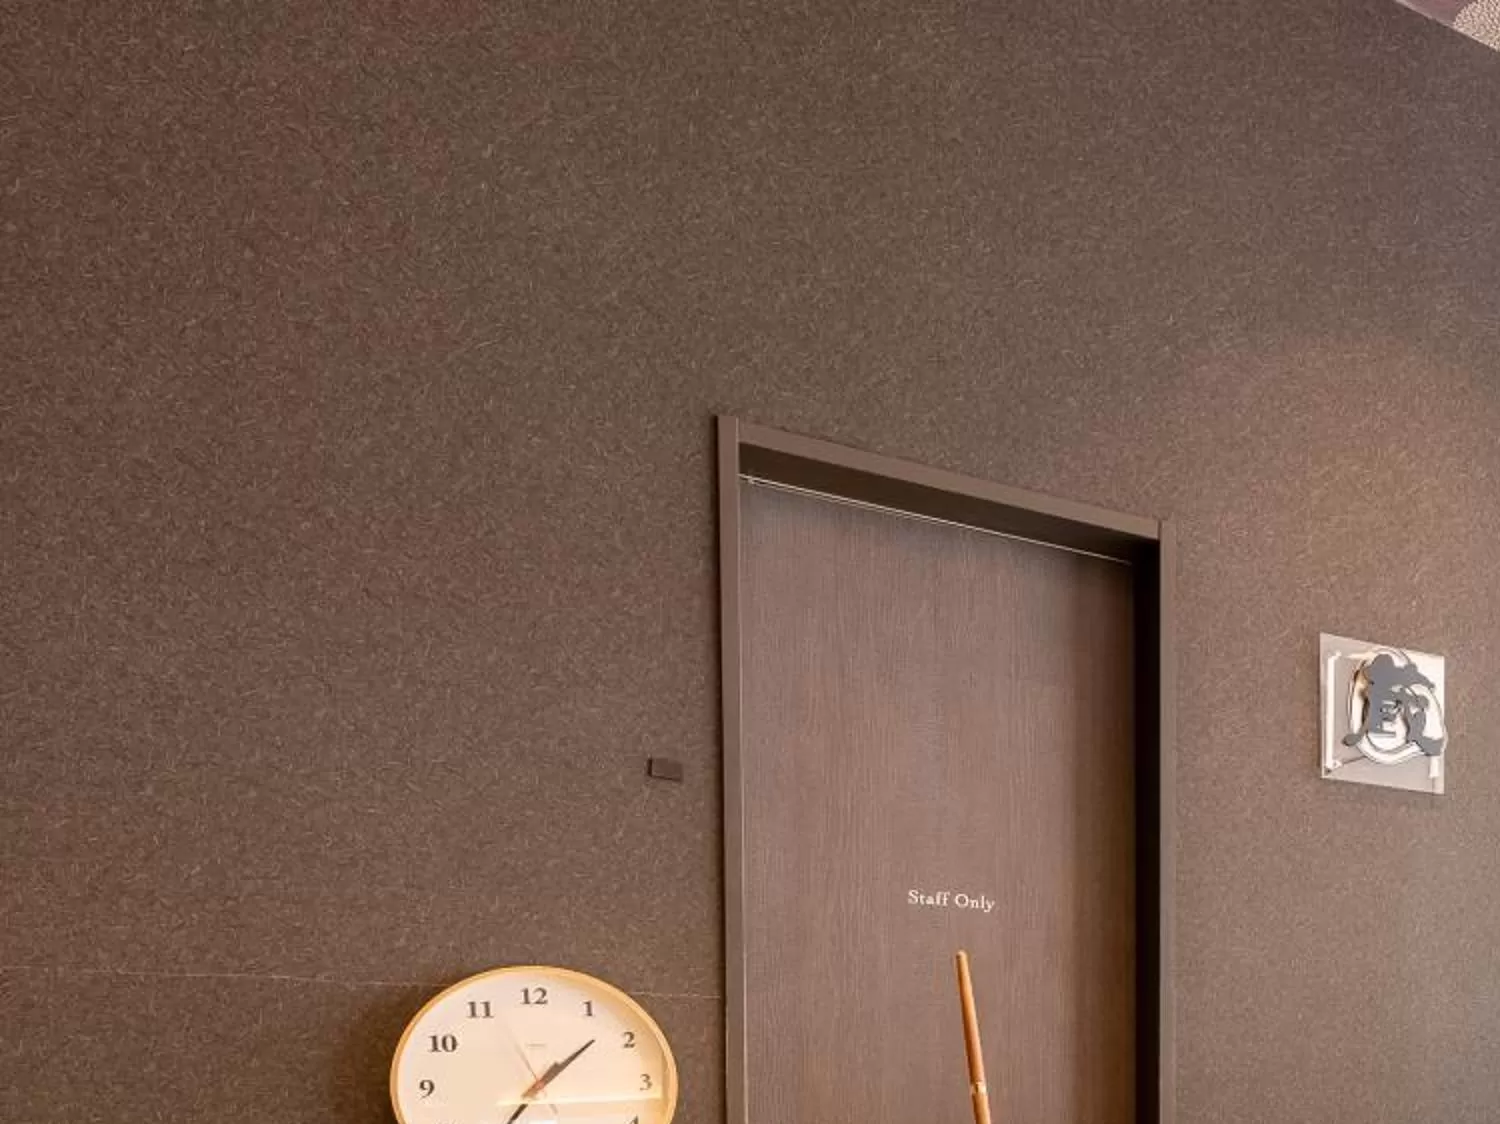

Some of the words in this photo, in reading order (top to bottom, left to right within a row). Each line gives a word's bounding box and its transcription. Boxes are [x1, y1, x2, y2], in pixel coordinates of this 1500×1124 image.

[907, 889, 951, 907] Staff
[955, 893, 996, 913] Only
[520, 987, 548, 1005] 12
[466, 1001, 494, 1018] 11
[583, 1000, 595, 1017] 1
[428, 1034, 458, 1052] 10
[623, 1031, 636, 1049] 2
[418, 1079, 435, 1098] 9
[639, 1073, 653, 1091] 3
